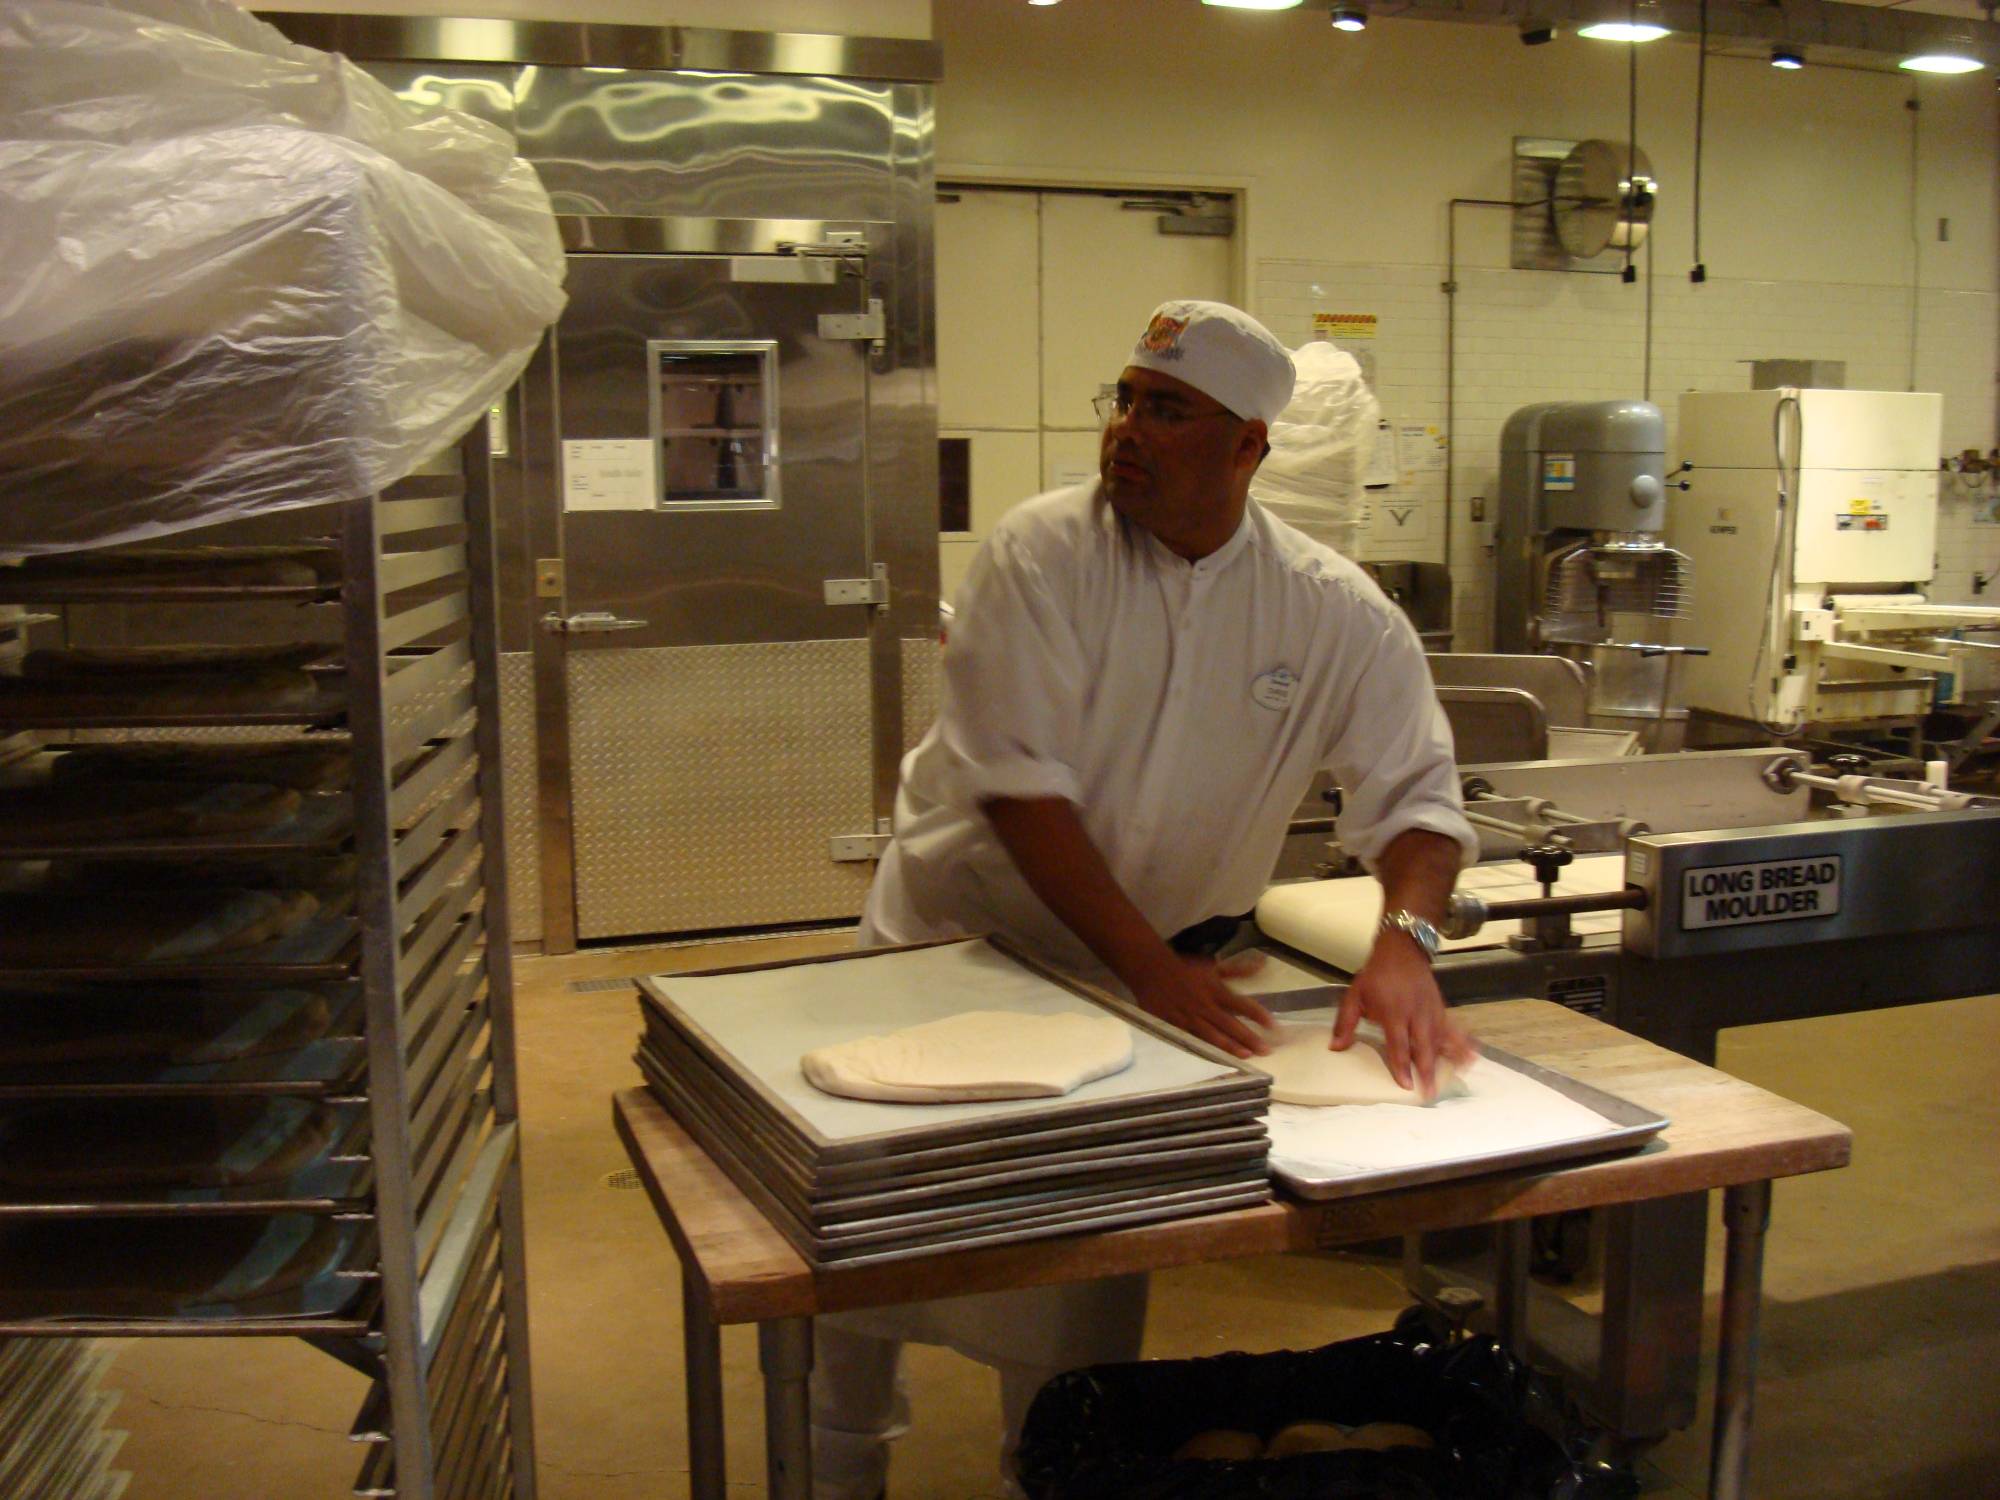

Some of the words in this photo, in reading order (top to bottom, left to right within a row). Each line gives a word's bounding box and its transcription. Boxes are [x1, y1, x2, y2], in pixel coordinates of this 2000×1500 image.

[1689, 871, 1754, 897] LONG
[1760, 863, 1836, 890] BREAD
[1706, 890, 1819, 921] MOULDER
